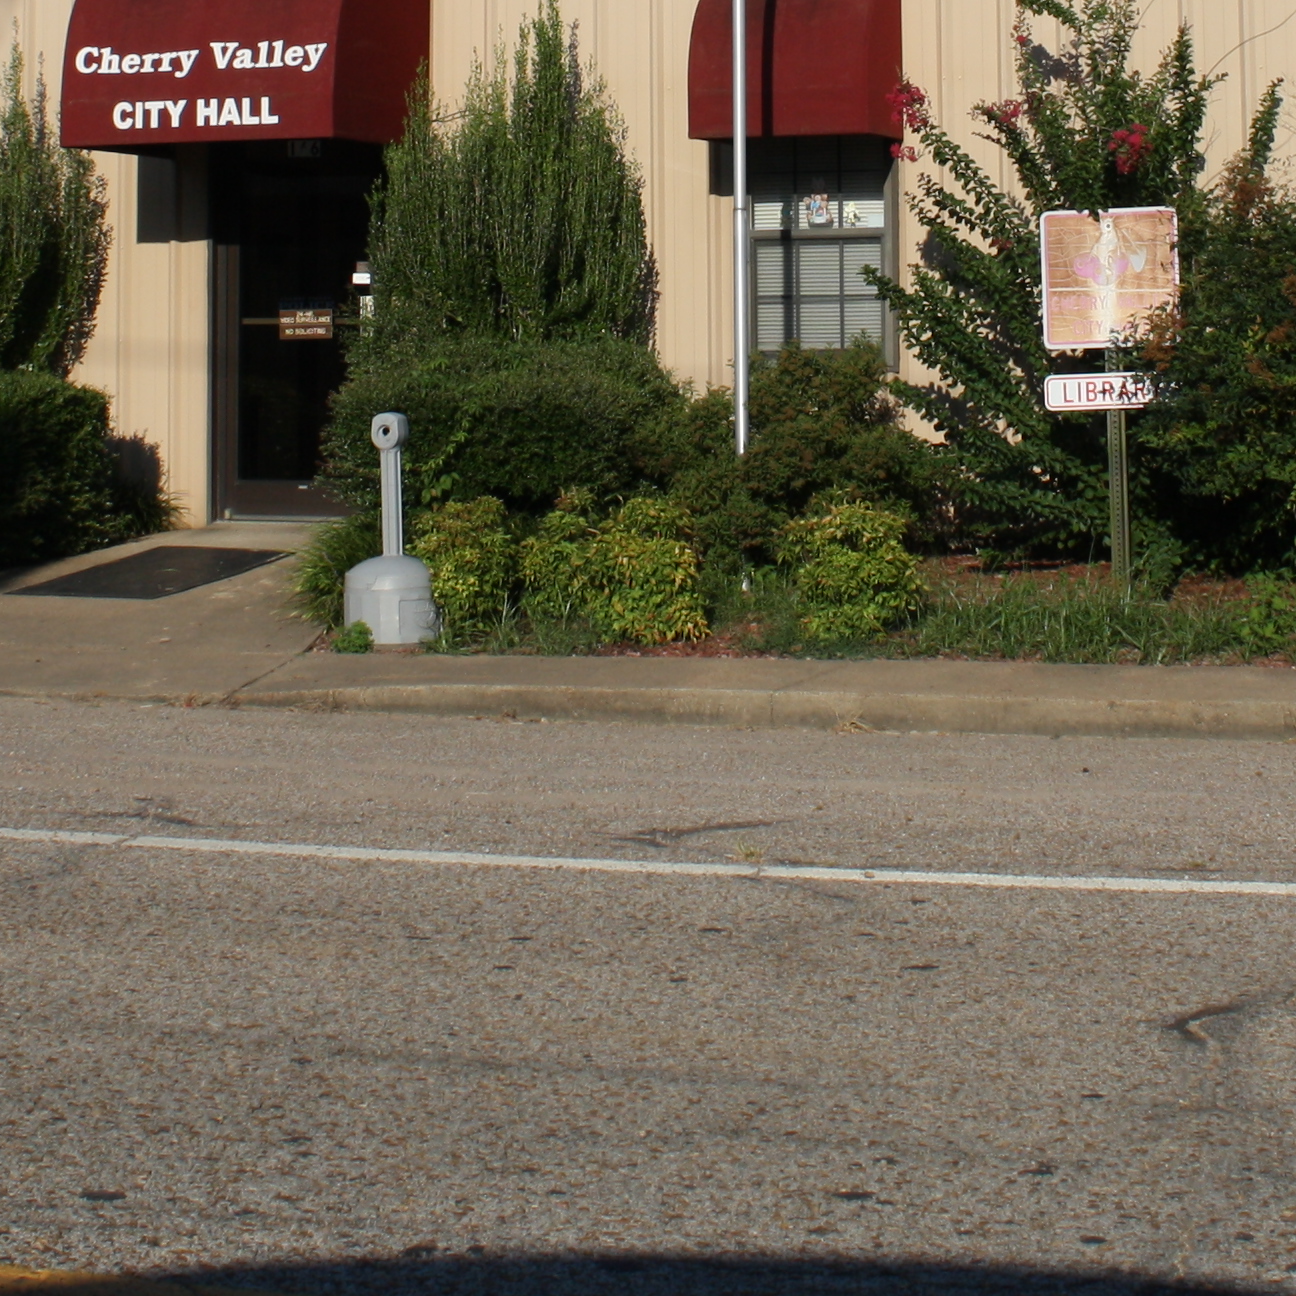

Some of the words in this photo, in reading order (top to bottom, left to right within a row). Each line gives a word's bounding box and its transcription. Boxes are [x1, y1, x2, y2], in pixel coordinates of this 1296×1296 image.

[74, 46, 200, 79] Cherry
[209, 40, 328, 72] Valley
[112, 99, 188, 130] CITY
[196, 96, 280, 127] HALL
[1063, 379, 1157, 403] LIBRAR
